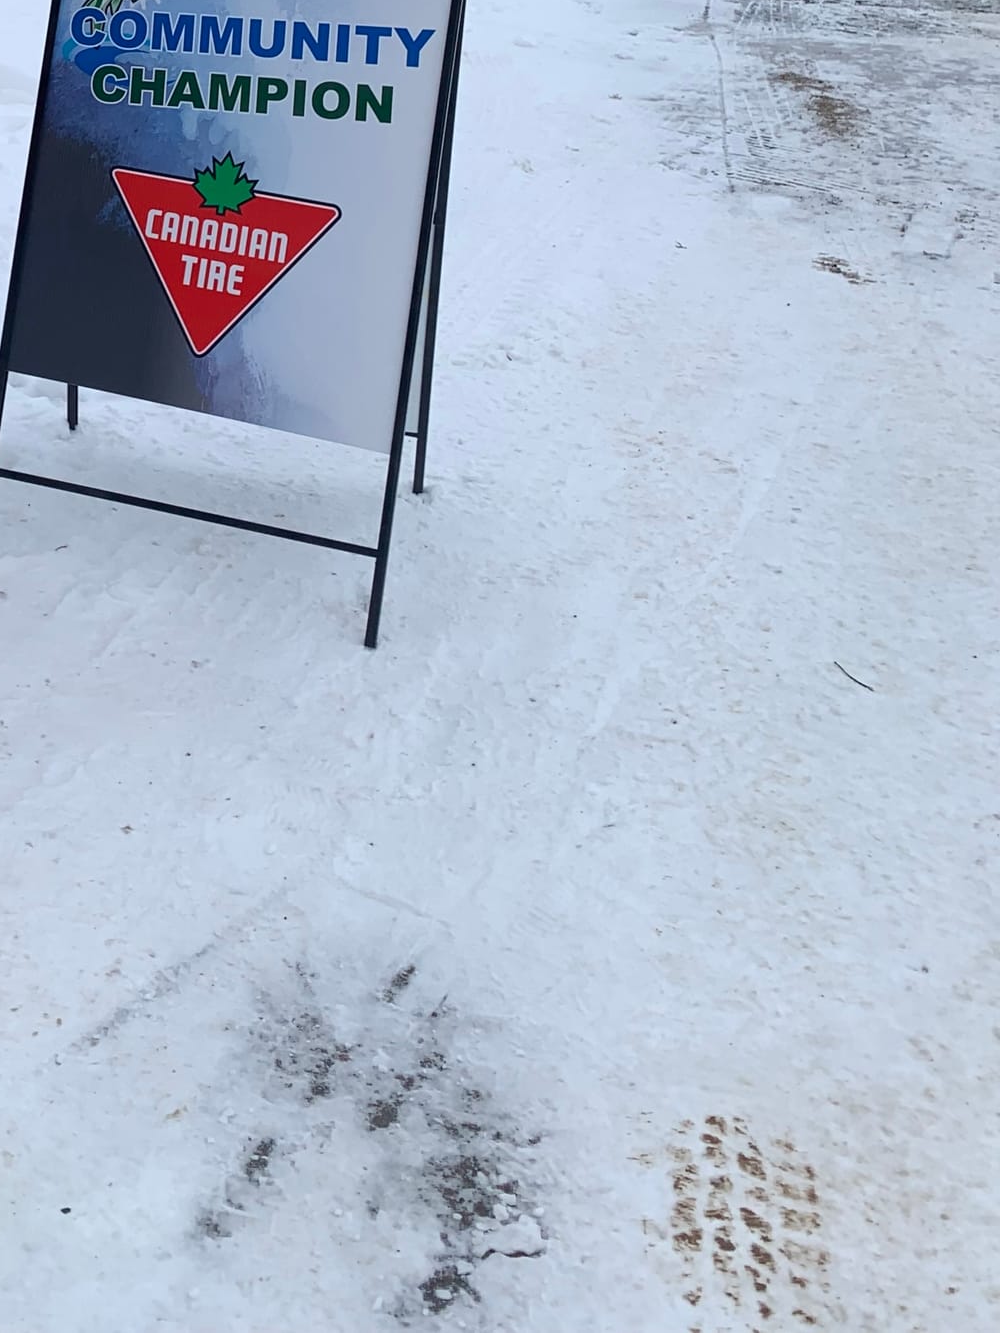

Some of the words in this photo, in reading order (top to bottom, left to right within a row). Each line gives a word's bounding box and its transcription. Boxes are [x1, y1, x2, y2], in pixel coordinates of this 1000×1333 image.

[70, 7, 437, 68] COMMUNITY
[91, 64, 395, 124] CHAMPION
[144, 208, 289, 264] CANADIAN
[181, 254, 245, 296] TIRE
